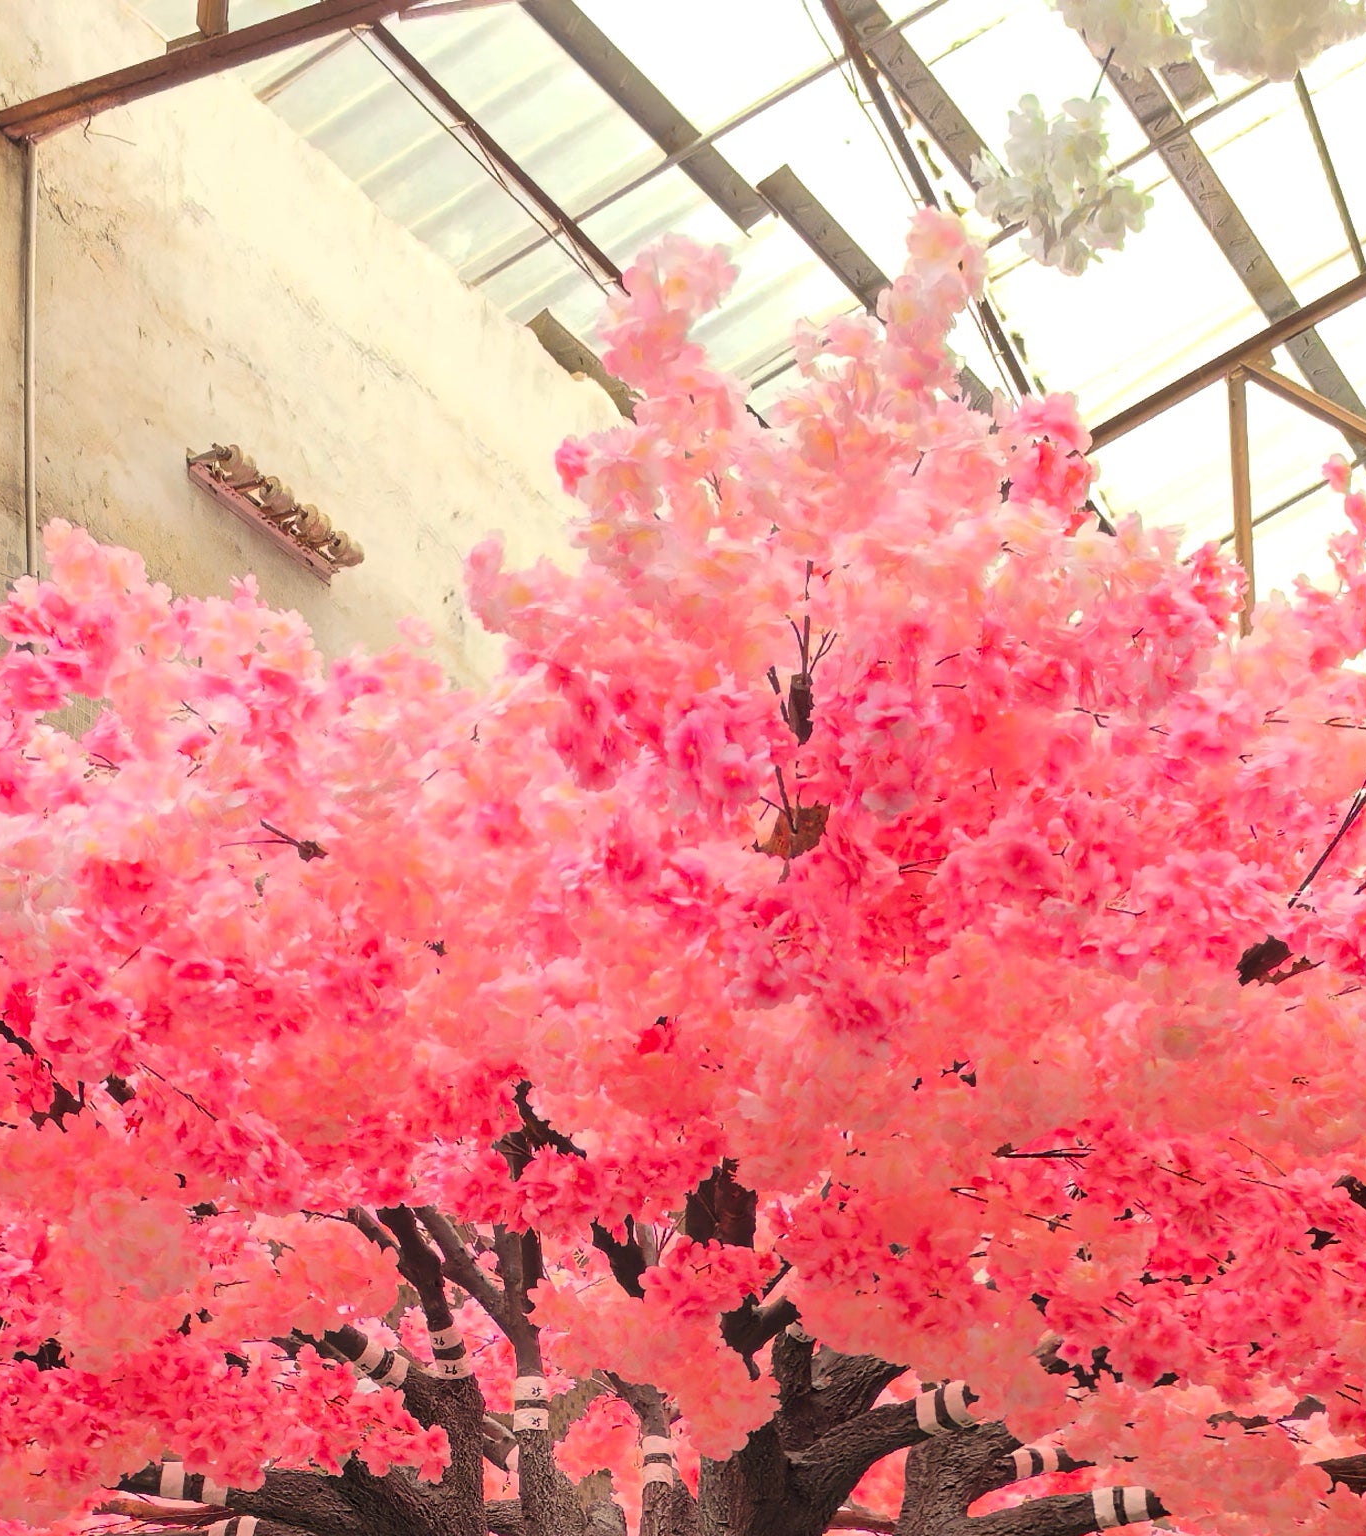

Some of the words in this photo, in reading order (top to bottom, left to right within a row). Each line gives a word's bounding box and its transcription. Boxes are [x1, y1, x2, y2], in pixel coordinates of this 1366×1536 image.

[433, 1336, 445, 1346] 26
[444, 1363, 458, 1375] 26
[531, 1386, 542, 1398] 25
[531, 1417, 542, 1428] 25
